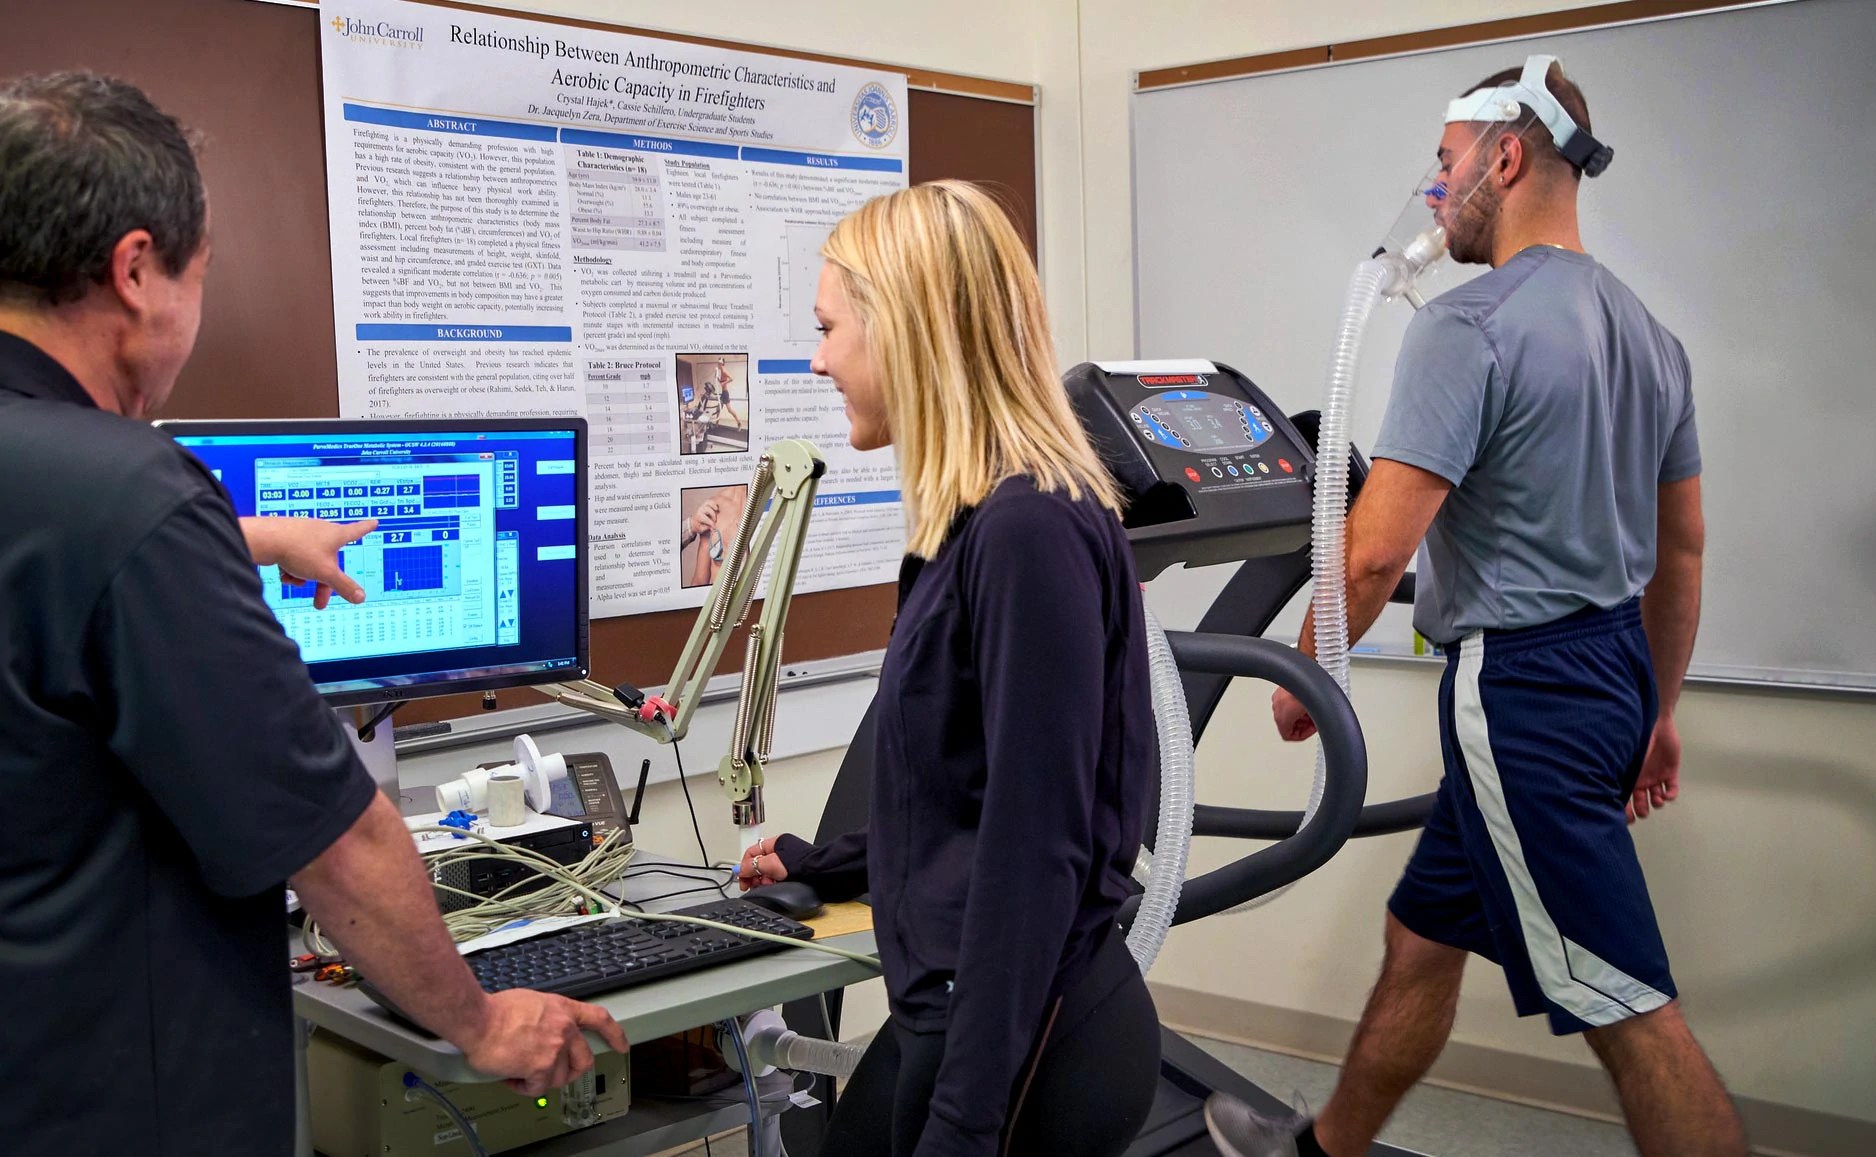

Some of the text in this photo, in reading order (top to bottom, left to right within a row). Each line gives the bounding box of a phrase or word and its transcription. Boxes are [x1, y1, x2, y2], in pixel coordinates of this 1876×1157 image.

[342, 18, 424, 42] John Carroll
[351, 35, 423, 50] UNIVERSITY
[450, 25, 835, 92] Relationship Between Anthropometric Characteristics and
[552, 68, 764, 109] Aerobic Capacity in Firefighters
[556, 93, 584, 105] Crystal
[616, 101, 641, 111] Cassie
[677, 107, 727, 121] Undergraduate
[727, 113, 755, 124] Students
[427, 120, 477, 132] ABSTRACT
[527, 104, 540, 114] Dr.
[541, 106, 580, 120] Jacquelyn
[582, 110, 601, 121] Zera,
[603, 113, 646, 125] Department
[656, 119, 686, 130] Exercise
[687, 122, 714, 132] Science
[714, 126, 728, 134] and
[728, 128, 749, 137] Sports
[749, 129, 773, 139] Studies
[353, 129, 389, 141] Firefighting
[412, 136, 442, 147] physically
[447, 139, 482, 150] demanding
[486, 143, 518, 151] profession
[540, 147, 554, 156] high
[633, 139, 672, 150] METHODS
[603, 152, 644, 163] Demographic
[806, 156, 838, 165] RESULTS
[664, 159, 710, 170] Study Population
[574, 256, 612, 264] Methodology
[382, 311, 403, 320] ability
[437, 328, 502, 337] BACKGROUND
[383, 348, 418, 357] prevalence
[432, 348, 466, 357] overweight
[484, 348, 505, 357] obesity
[546, 349, 571, 357] epidemic
[367, 373, 405, 383] firefighters
[475, 373, 497, 382] general
[498, 373, 531, 381] population,
[391, 531, 448, 542] 2.7 0
